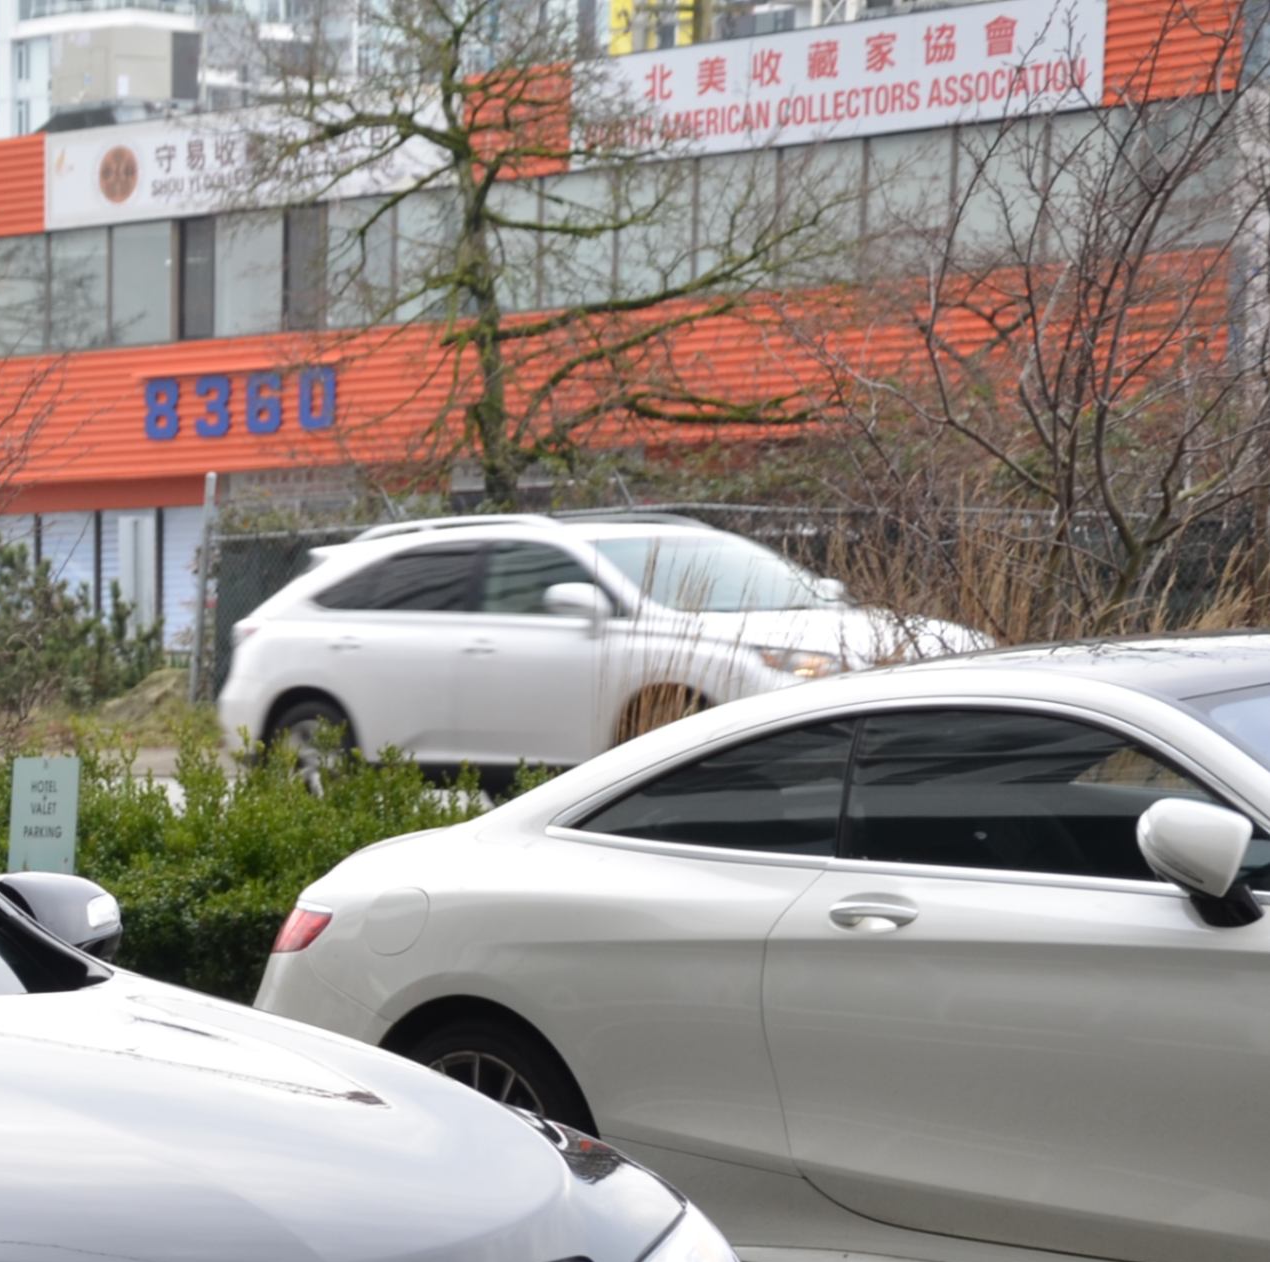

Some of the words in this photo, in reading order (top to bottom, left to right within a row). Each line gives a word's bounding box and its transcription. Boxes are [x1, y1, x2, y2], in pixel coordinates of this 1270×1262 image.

[644, 15, 1020, 102] 北美收藏家協會
[659, 101, 771, 141] AMERICAN
[777, 81, 921, 128] COLLECTORS
[928, 58, 1089, 109] ASSOCIATION
[144, 366, 337, 440] 8360
[30, 780, 58, 793] HOTEL
[30, 802, 57, 815] VALET
[23, 825, 63, 839] PARKING
